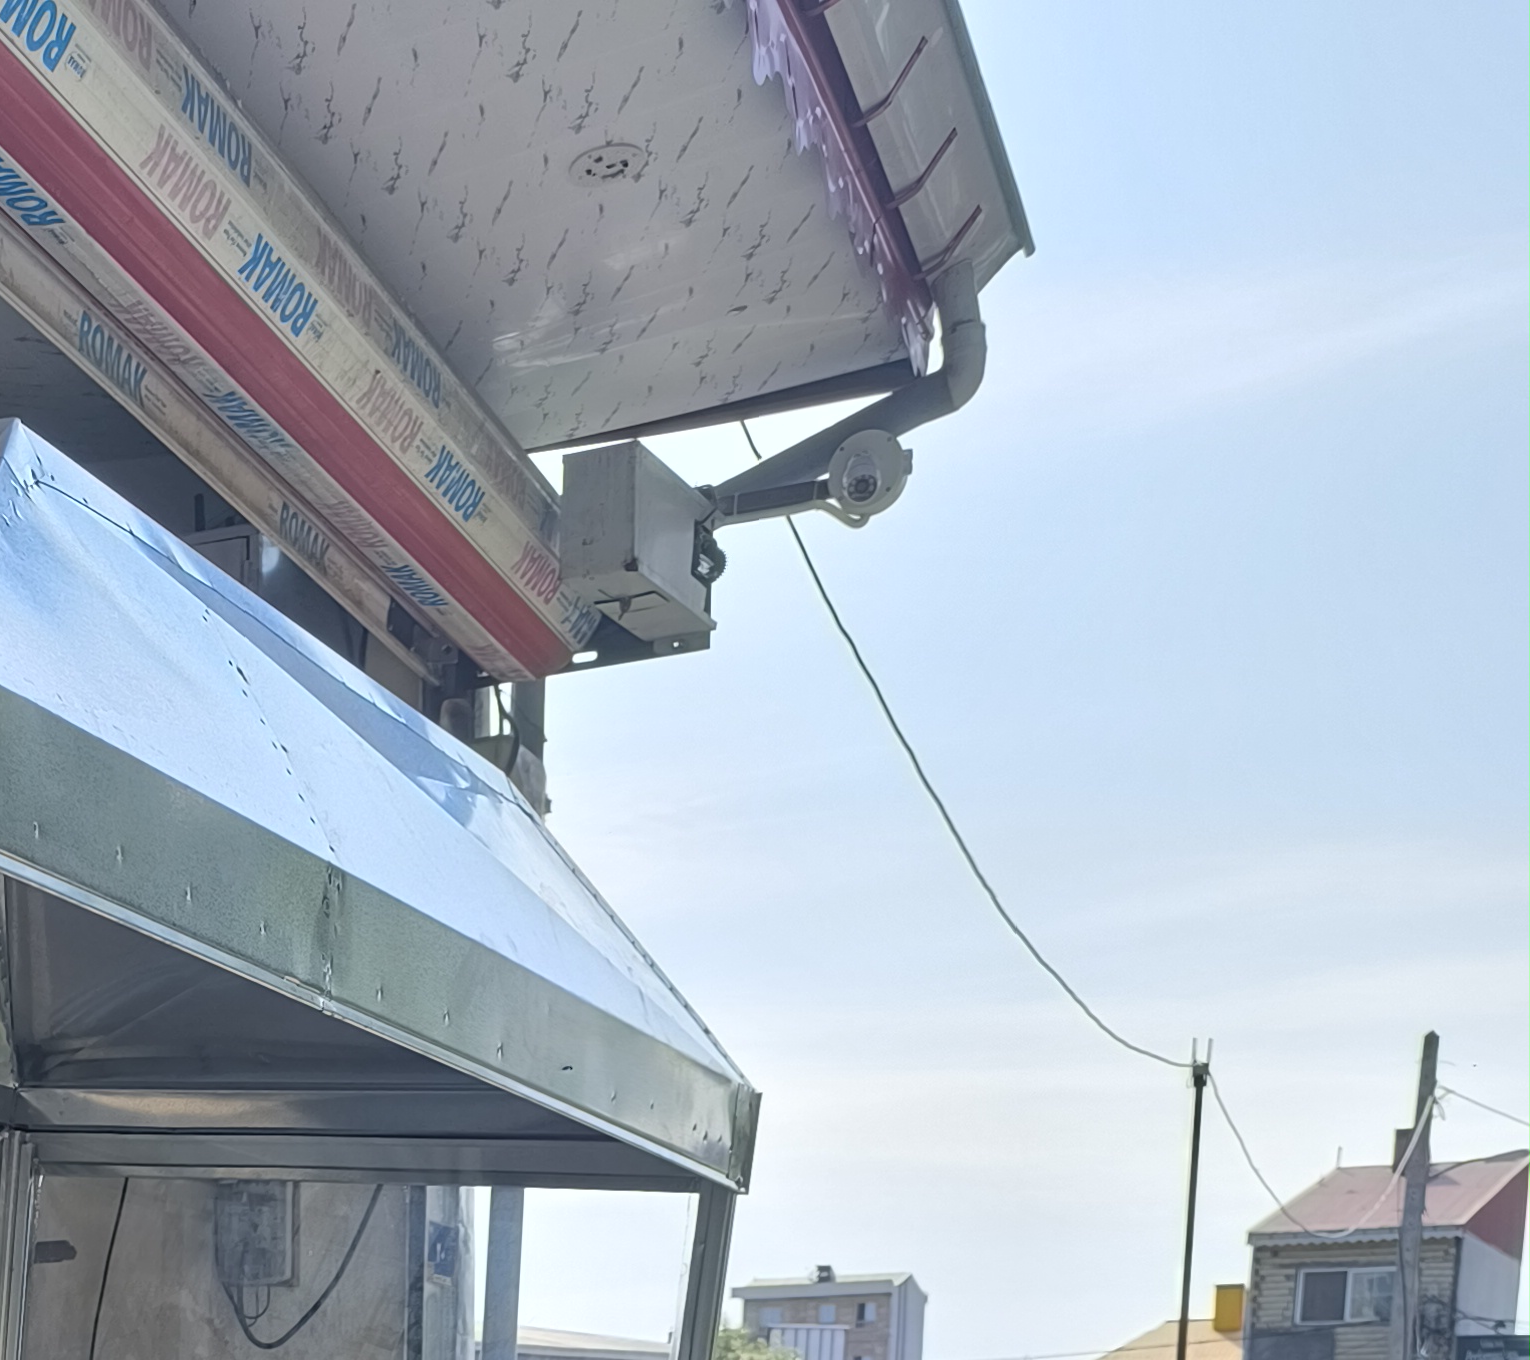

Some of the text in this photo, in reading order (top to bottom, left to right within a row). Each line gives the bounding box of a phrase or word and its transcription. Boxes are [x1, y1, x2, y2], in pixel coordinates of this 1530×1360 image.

[181, 63, 252, 188] ROMAK
[139, 123, 232, 241] ROMAK
[237, 232, 318, 338] ROMAK
[78, 309, 148, 409] ROMAK
[423, 445, 486, 522] ROMAK
